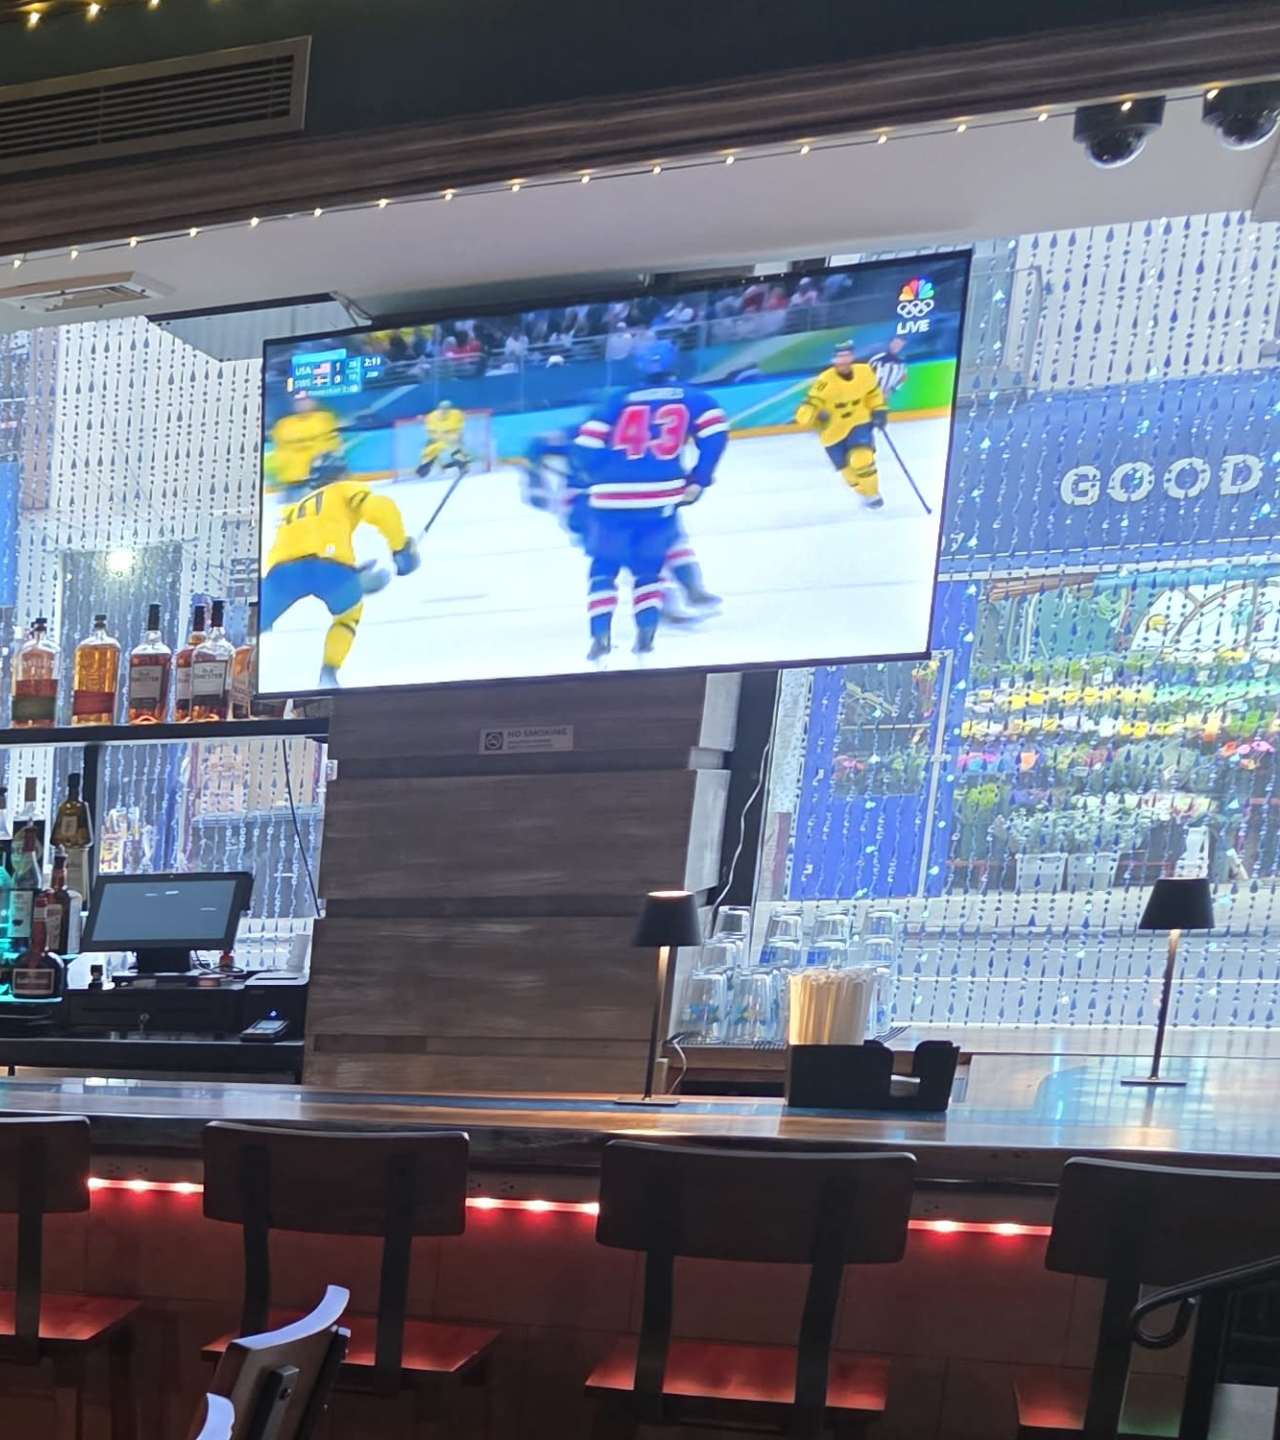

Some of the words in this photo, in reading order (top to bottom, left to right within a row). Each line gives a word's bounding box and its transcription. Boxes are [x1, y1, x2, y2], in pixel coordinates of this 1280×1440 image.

[896, 319, 931, 335] LIVE
[612, 403, 690, 460] 43
[1059, 453, 1265, 507] GOOD
